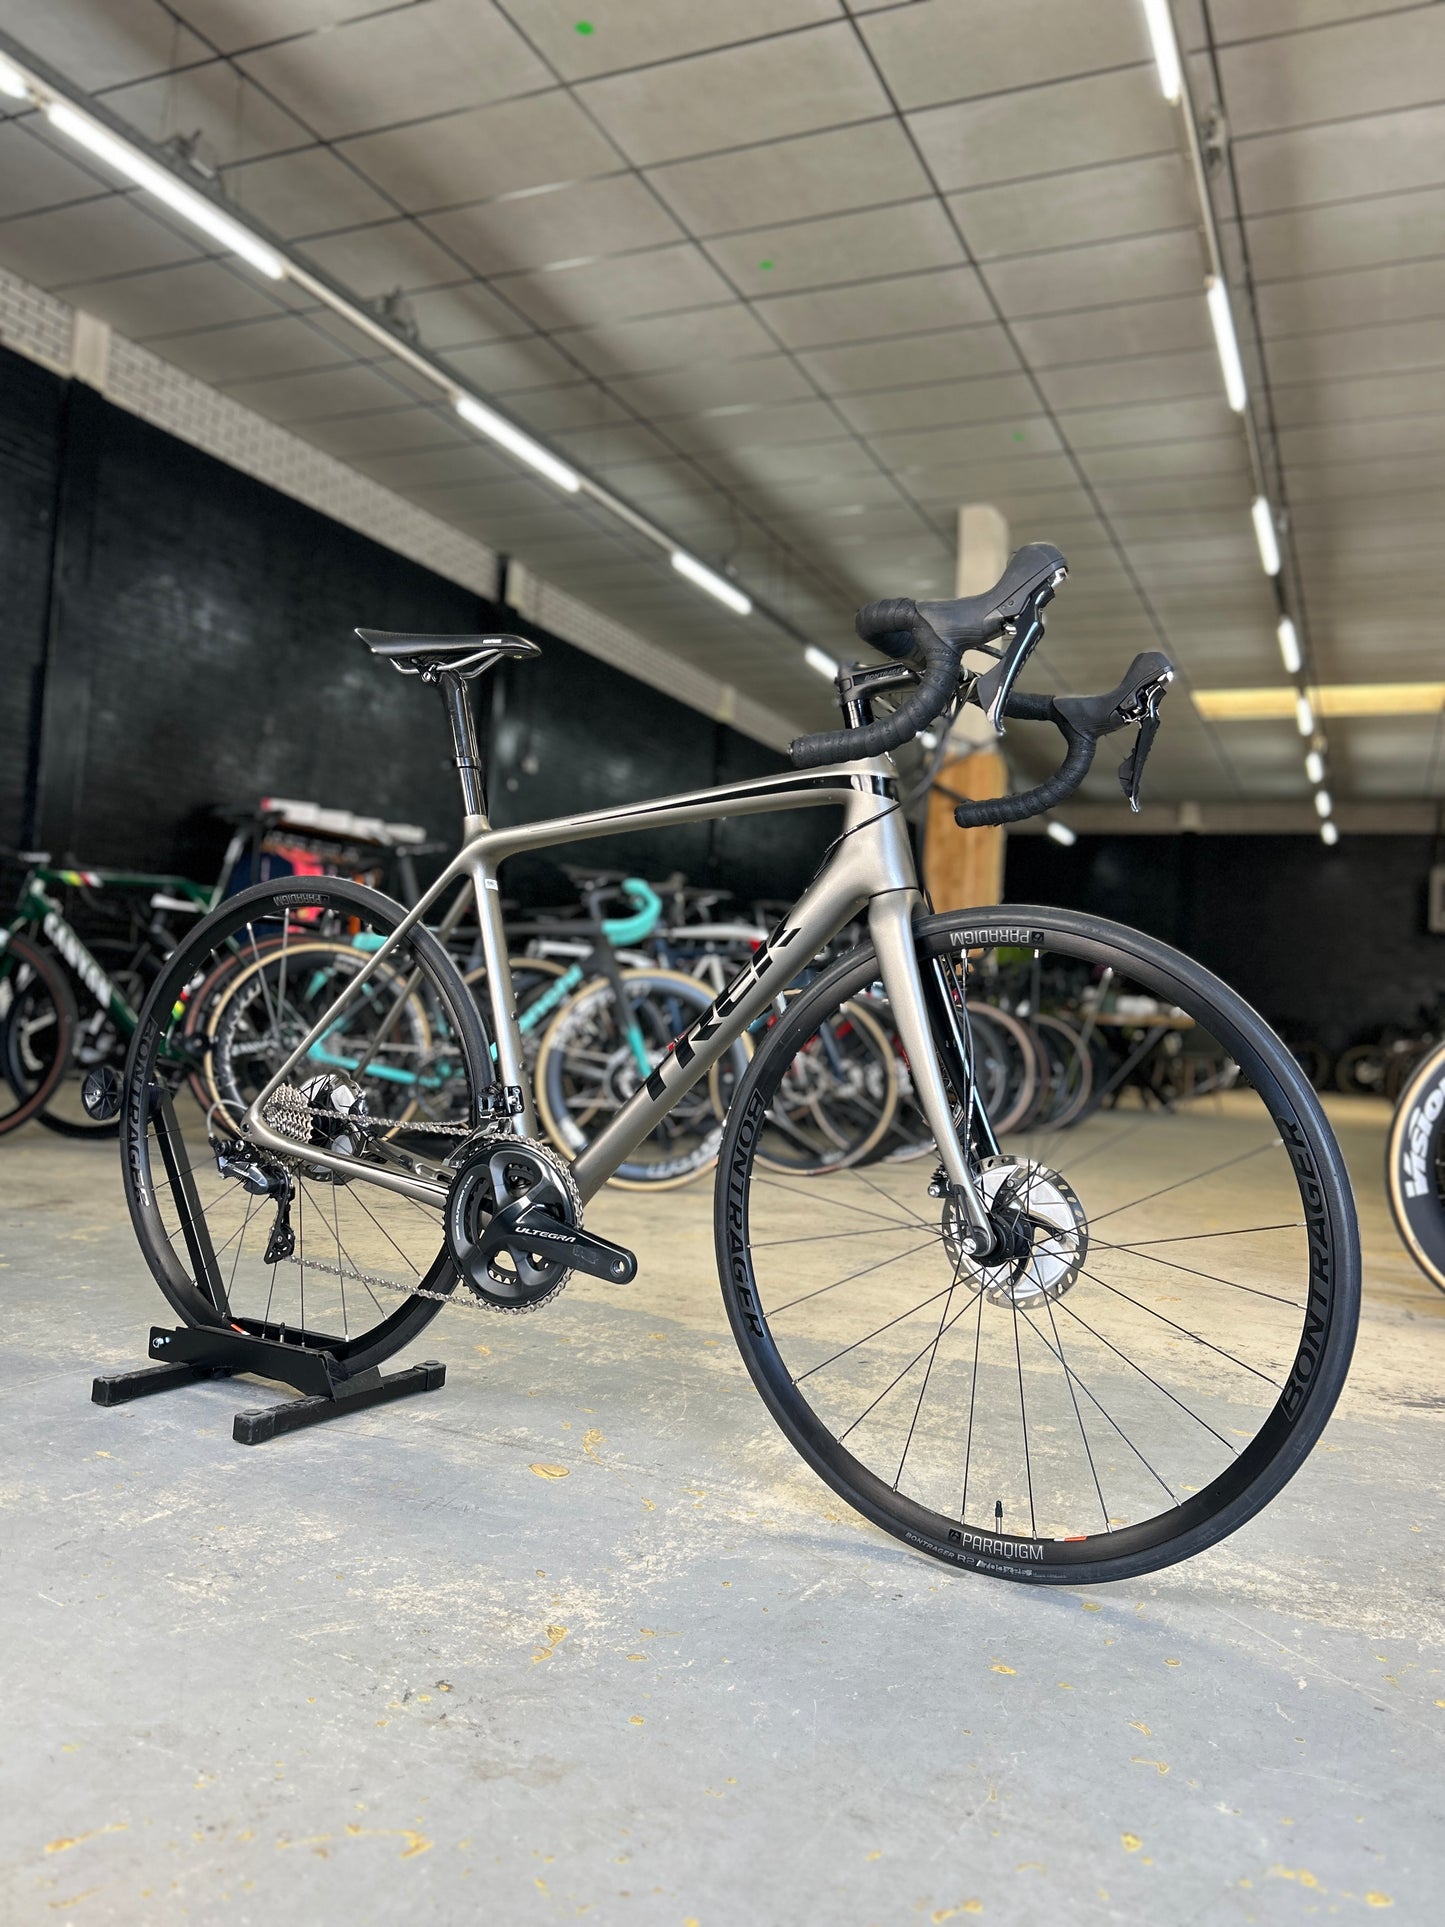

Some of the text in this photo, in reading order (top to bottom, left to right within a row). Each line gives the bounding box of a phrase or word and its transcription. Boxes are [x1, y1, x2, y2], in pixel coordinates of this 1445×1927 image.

[273, 893, 322, 906] PARADIGM
[950, 930, 1030, 946] PARADIGM
[646, 912, 802, 1101] TREK
[127, 1020, 157, 1207] BONTRAGER
[728, 1089, 766, 1338] BONTRAGER
[515, 1226, 577, 1243] ULTEGRA
[1277, 1115, 1330, 1422] BONTRAGER
[904, 1531, 955, 1558] BONTRAGER
[962, 1532, 1044, 1560] PARADIGM
